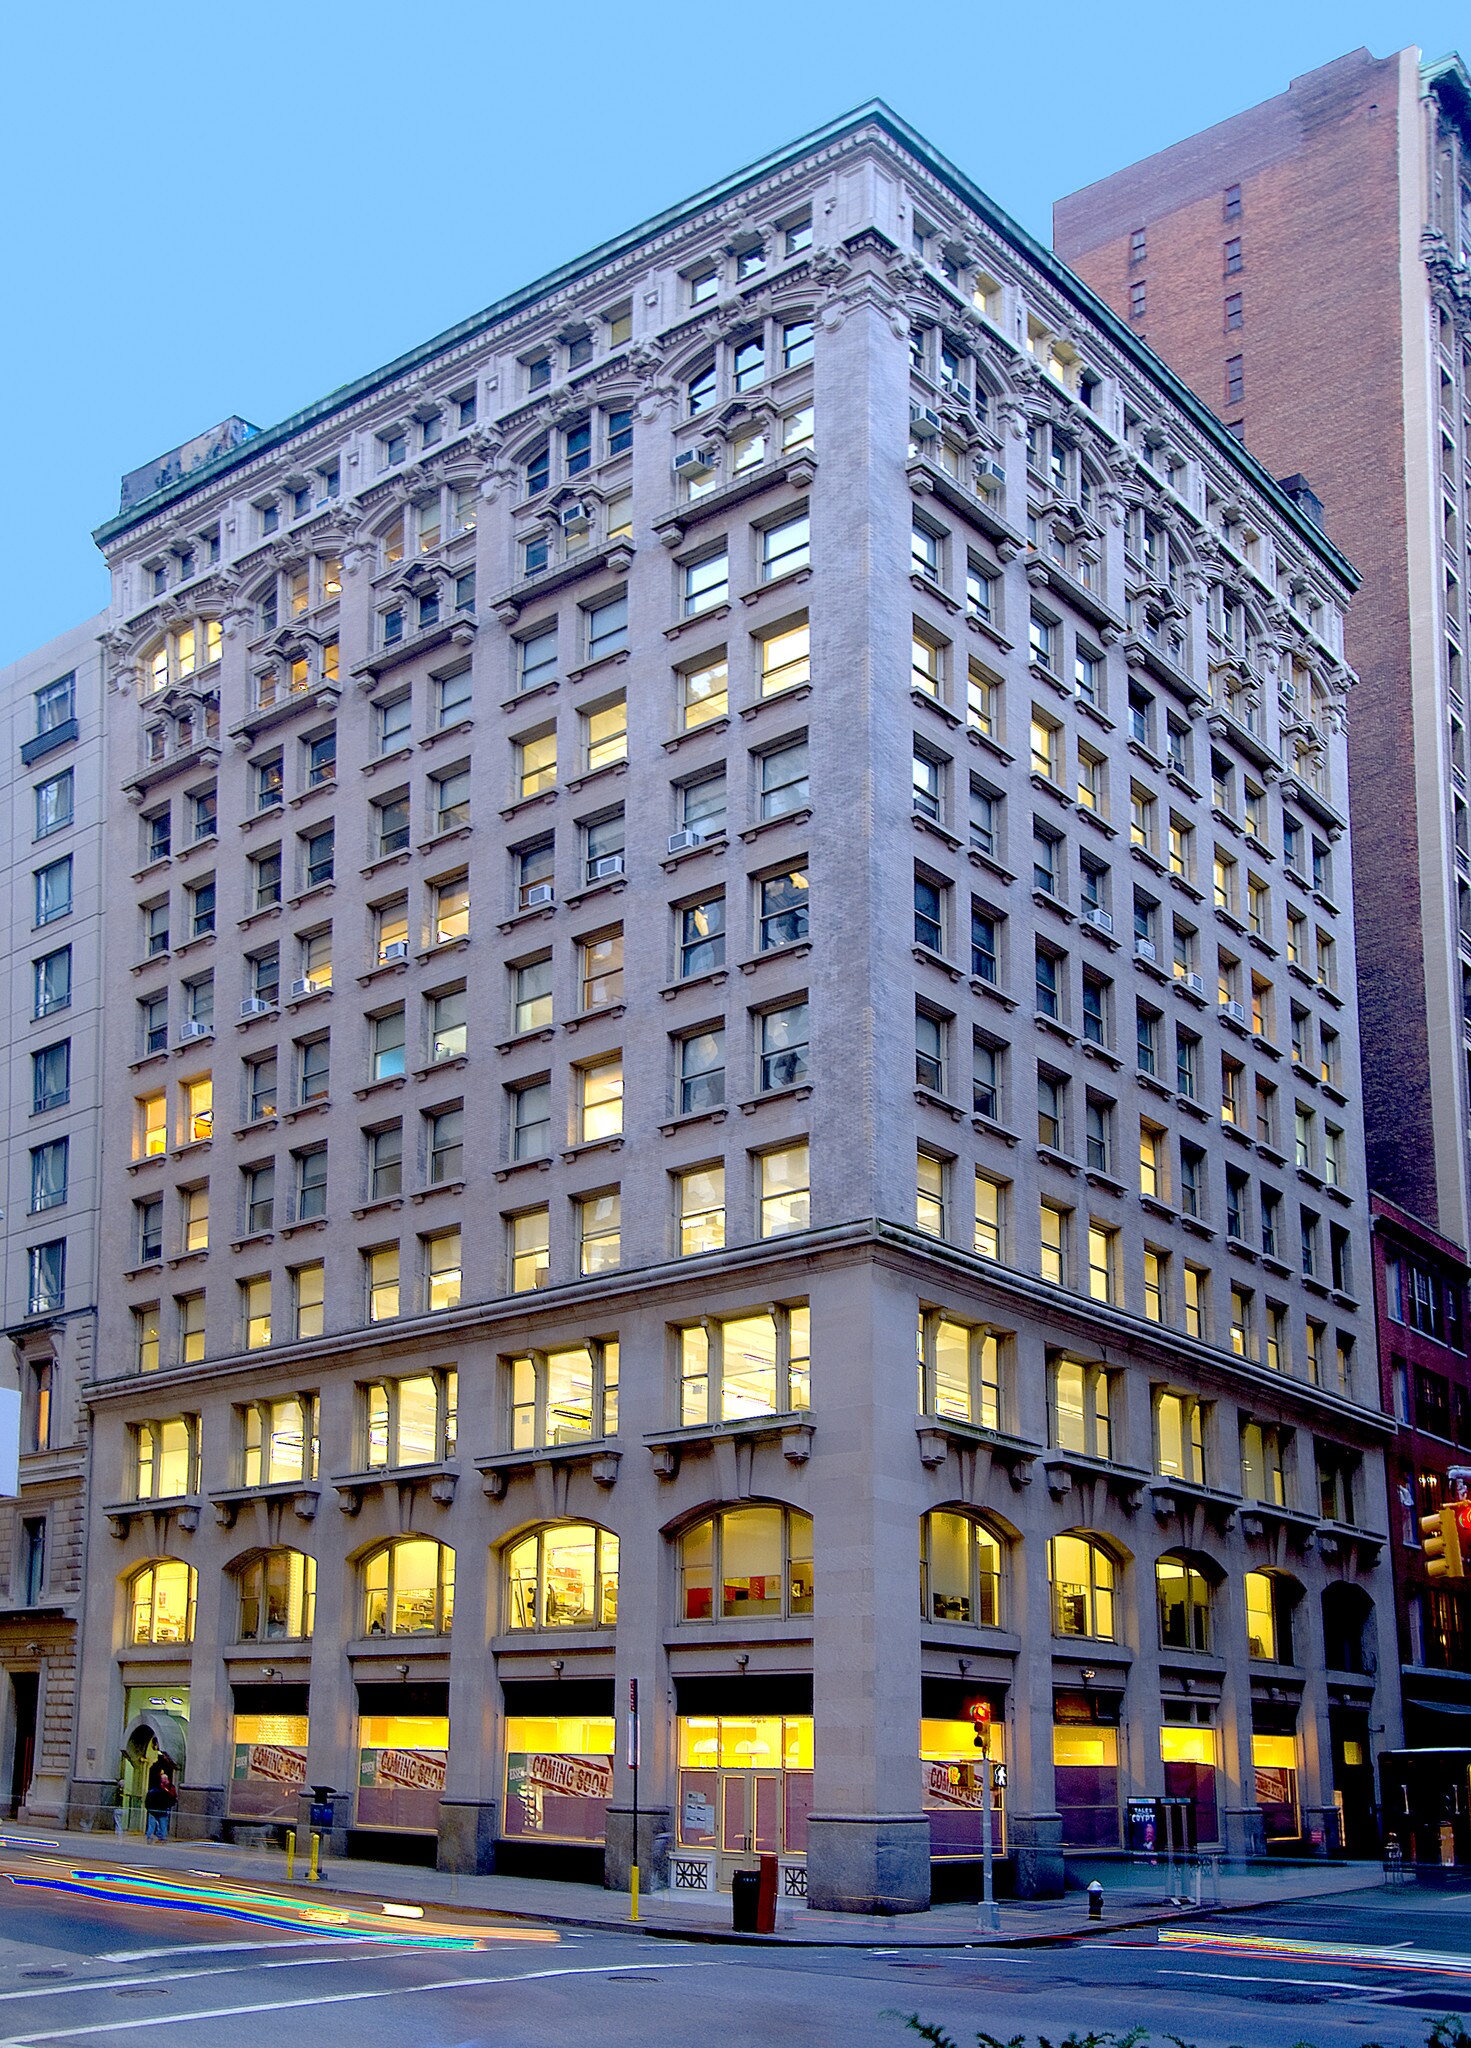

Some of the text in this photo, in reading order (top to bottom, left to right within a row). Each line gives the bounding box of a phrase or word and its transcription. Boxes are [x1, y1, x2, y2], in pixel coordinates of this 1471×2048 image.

[253, 1746, 283, 1773] COMING
[284, 1758, 307, 1782] SOON
[381, 1751, 446, 1789] COMING SOON
[532, 1755, 609, 1798] COMING SOON
